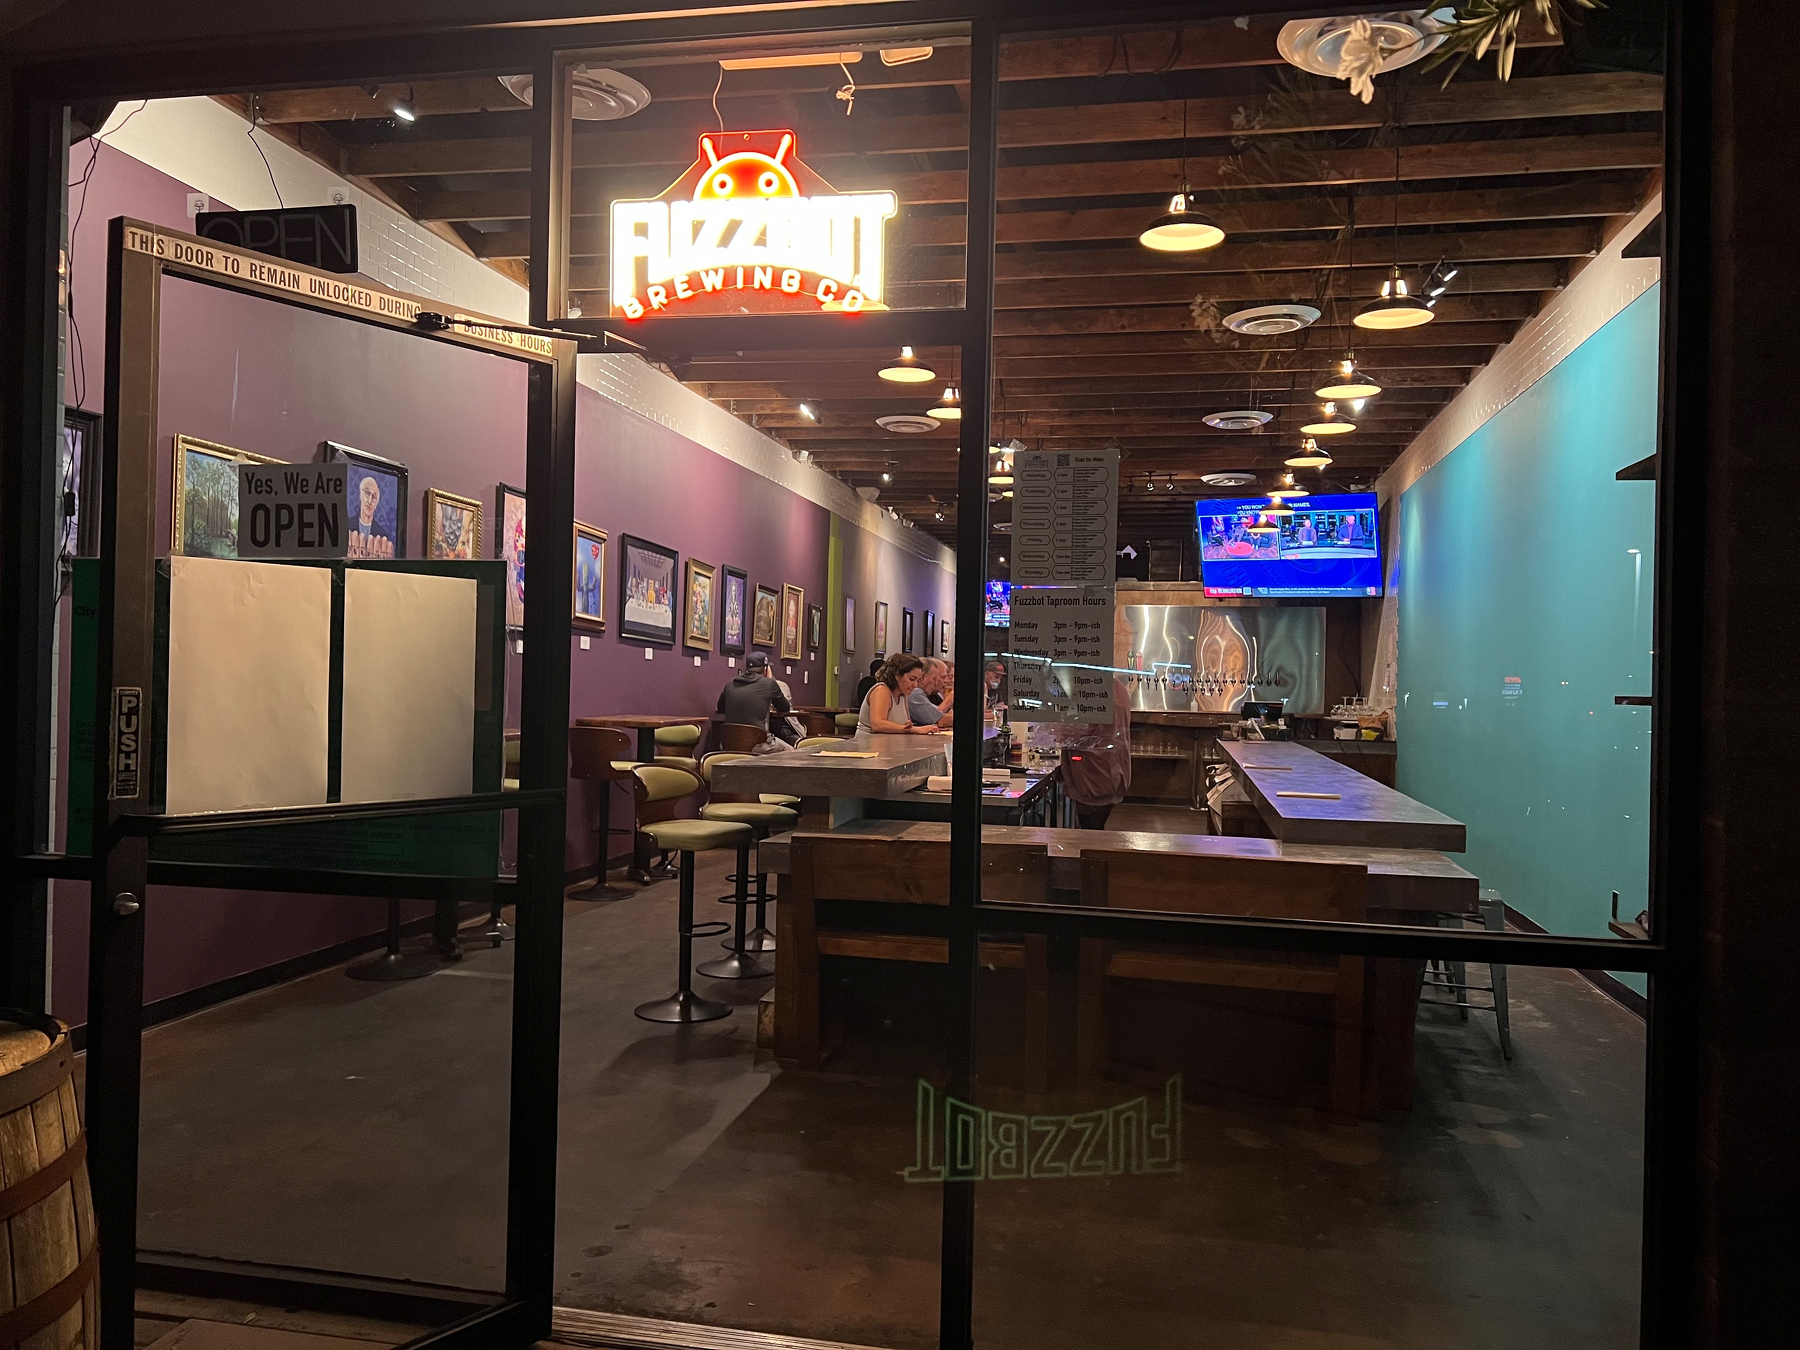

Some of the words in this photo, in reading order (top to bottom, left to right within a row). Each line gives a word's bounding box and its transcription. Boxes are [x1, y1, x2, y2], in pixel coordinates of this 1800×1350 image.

[128, 230, 165, 256] THIS
[174, 243, 214, 268] DOOR
[222, 255, 240, 274] TO
[250, 262, 300, 290] REMAIN
[309, 278, 372, 308] UNLOCKED
[520, 333, 552, 355] HOURS
[618, 266, 801, 319] BREWING
[816, 278, 865, 312] CO
[245, 472, 279, 496] Yes,
[284, 472, 309, 495] We
[315, 471, 343, 495] Are
[250, 503, 339, 548] OPEN
[1014, 596, 1044, 606] Fuzzbot
[1046, 596, 1080, 608] Taproom
[1082, 596, 1106, 606] Hours
[1014, 621, 1038, 630] Monday
[1053, 621, 1067, 630] 3pm
[1074, 621, 1101, 630] 9pm-ish
[1014, 635, 1039, 644] Tuesday
[1053, 635, 1067, 644] 3pm
[1073, 635, 1100, 644] 9pm-ish
[1013, 648, 1049, 659] Wednesday
[1053, 649, 1067, 658] 3pm
[1073, 648, 1100, 658] 9pm-ish
[1013, 676, 1032, 685] Friday
[1073, 676, 1104, 685] 10pm-ish
[1013, 689, 1040, 698] Saturday
[1079, 690, 1109, 699] 10pm-ish
[1053, 704, 1069, 712] 11am
[1077, 704, 1107, 713] 10pm-ish
[119, 696, 138, 771] PUSH
[904, 1072, 1182, 1182] FUZZBOT
